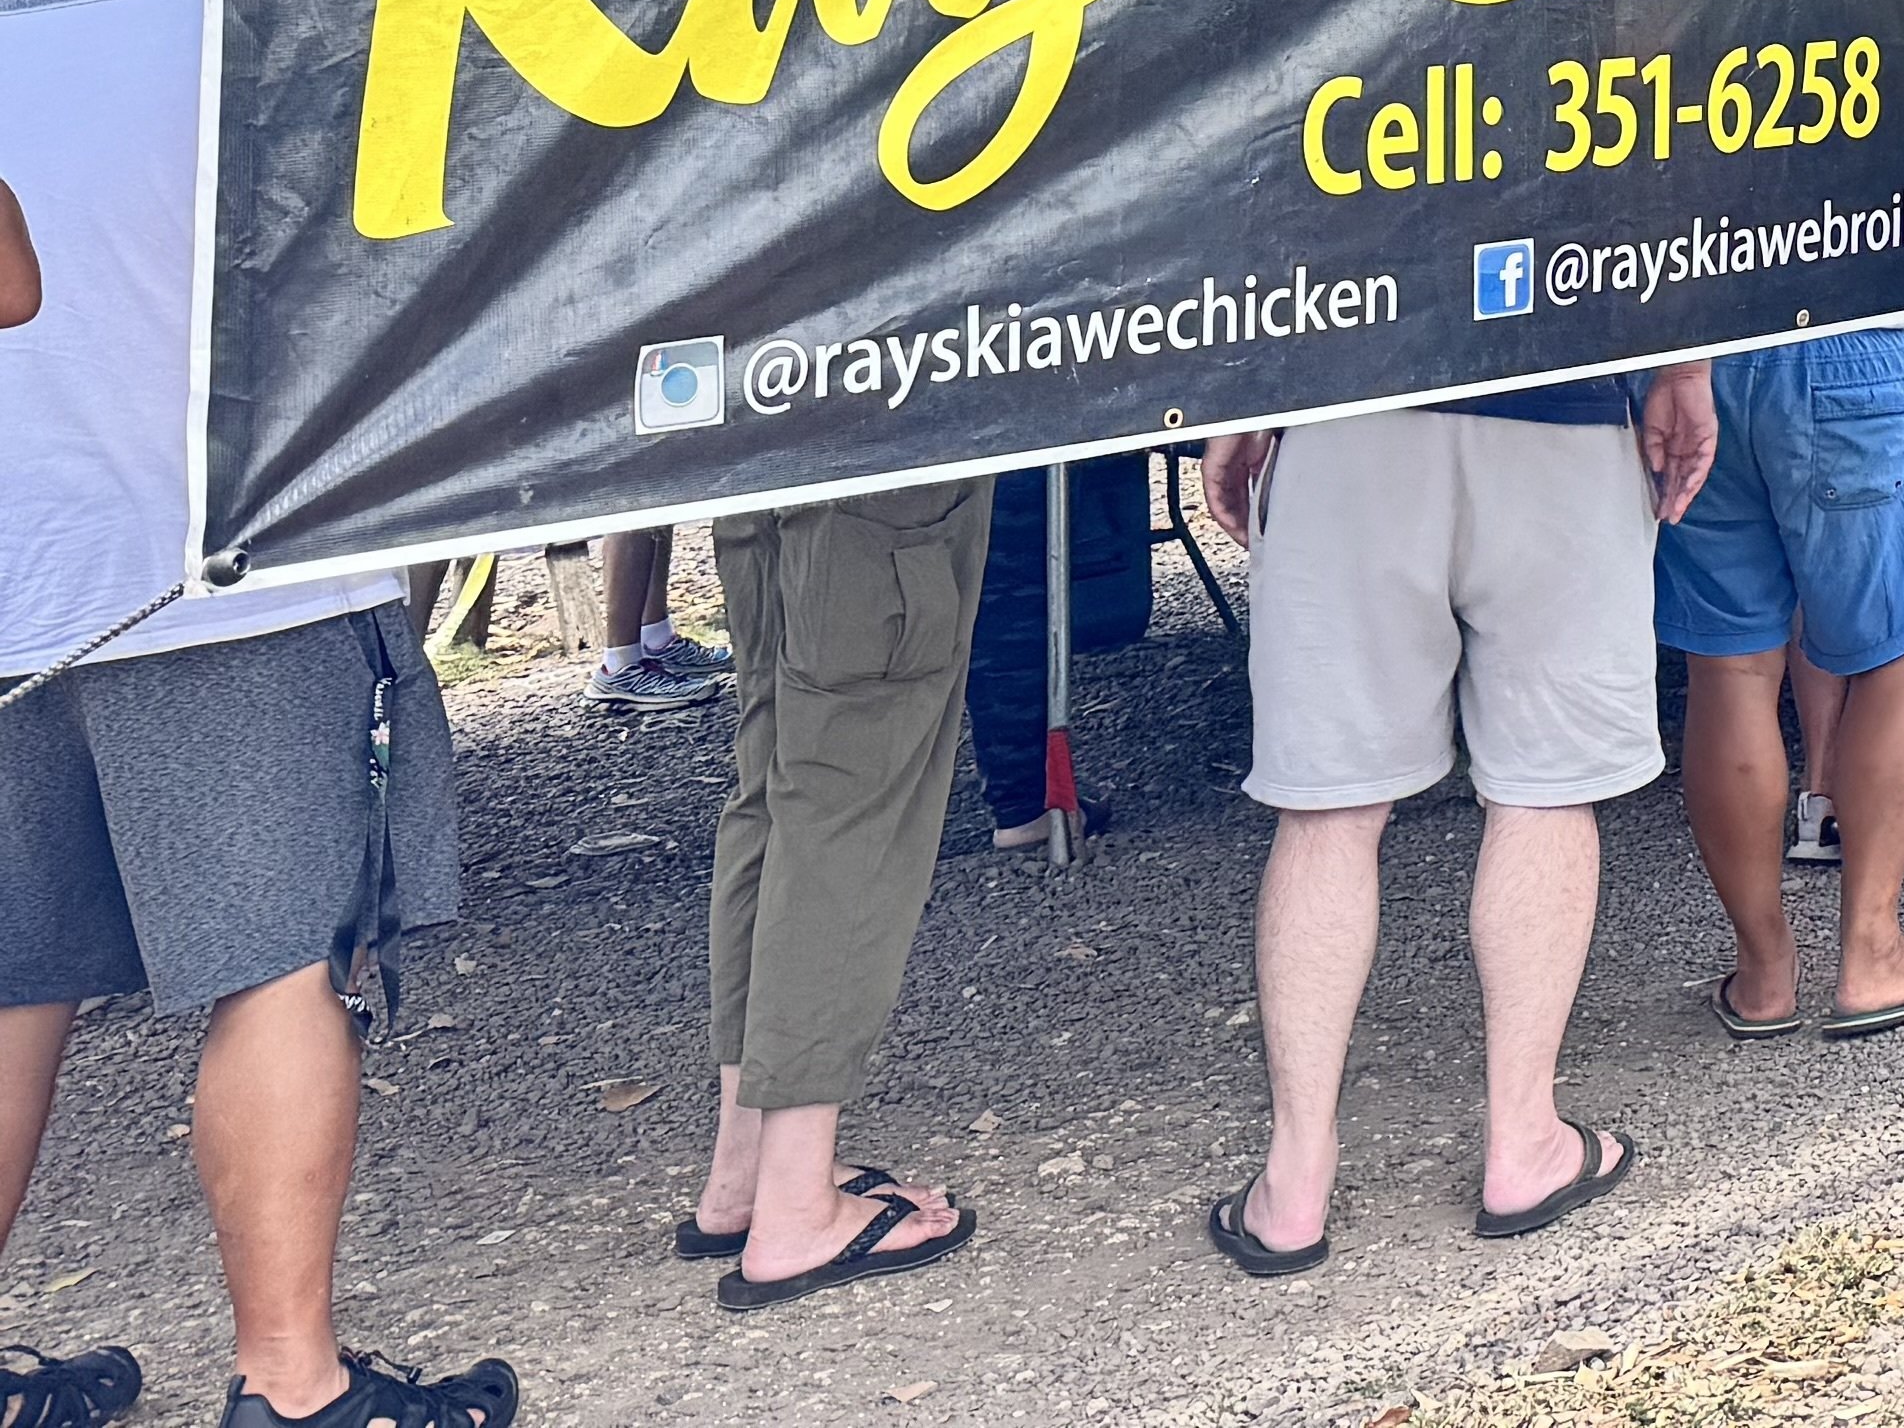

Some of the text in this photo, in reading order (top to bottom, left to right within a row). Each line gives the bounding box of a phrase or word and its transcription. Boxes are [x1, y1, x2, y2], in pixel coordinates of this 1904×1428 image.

[1305, 65, 1503, 197] Cell:
[1546, 38, 1881, 173] 351-6258
[742, 265, 1400, 416] @rayskiawechicken
